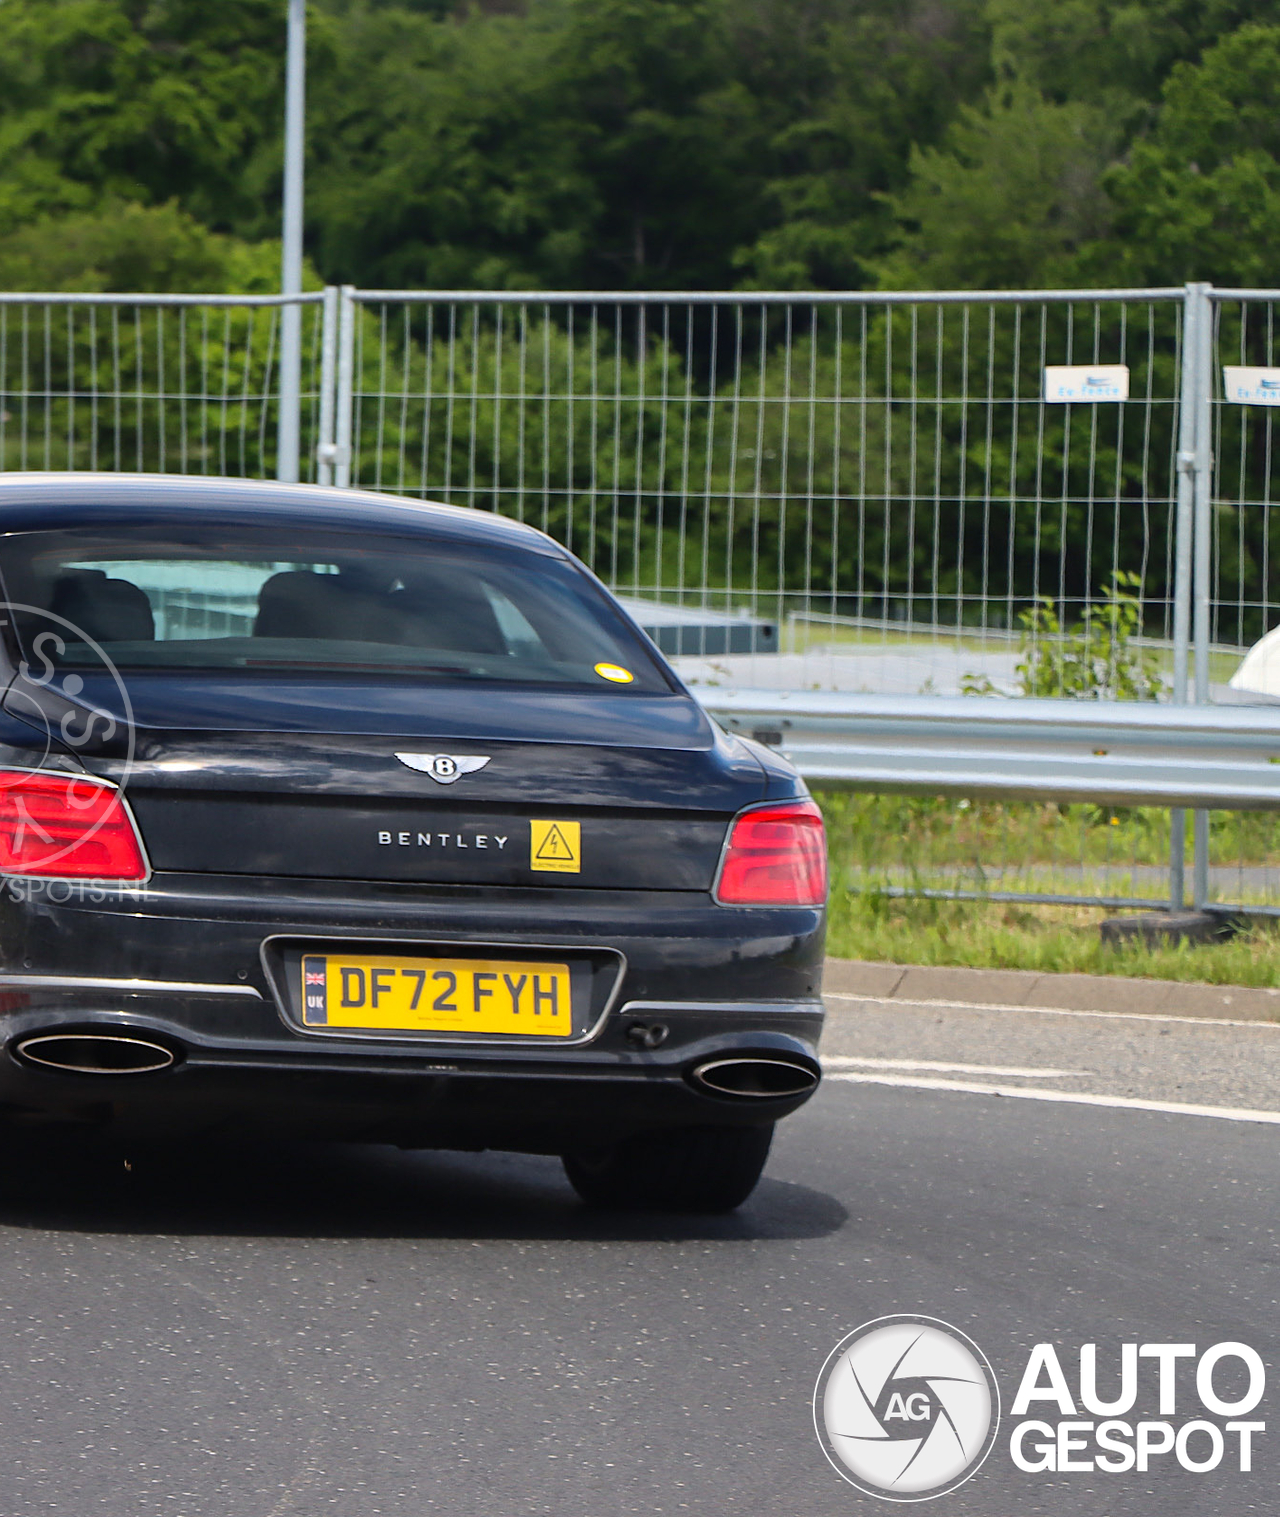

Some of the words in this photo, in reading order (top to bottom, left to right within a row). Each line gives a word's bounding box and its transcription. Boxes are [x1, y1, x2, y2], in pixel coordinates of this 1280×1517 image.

[378, 831, 507, 849] BENTLEY
[340, 967, 457, 1011] DF72
[473, 972, 557, 1016] FYH
[307, 995, 324, 1009] UK
